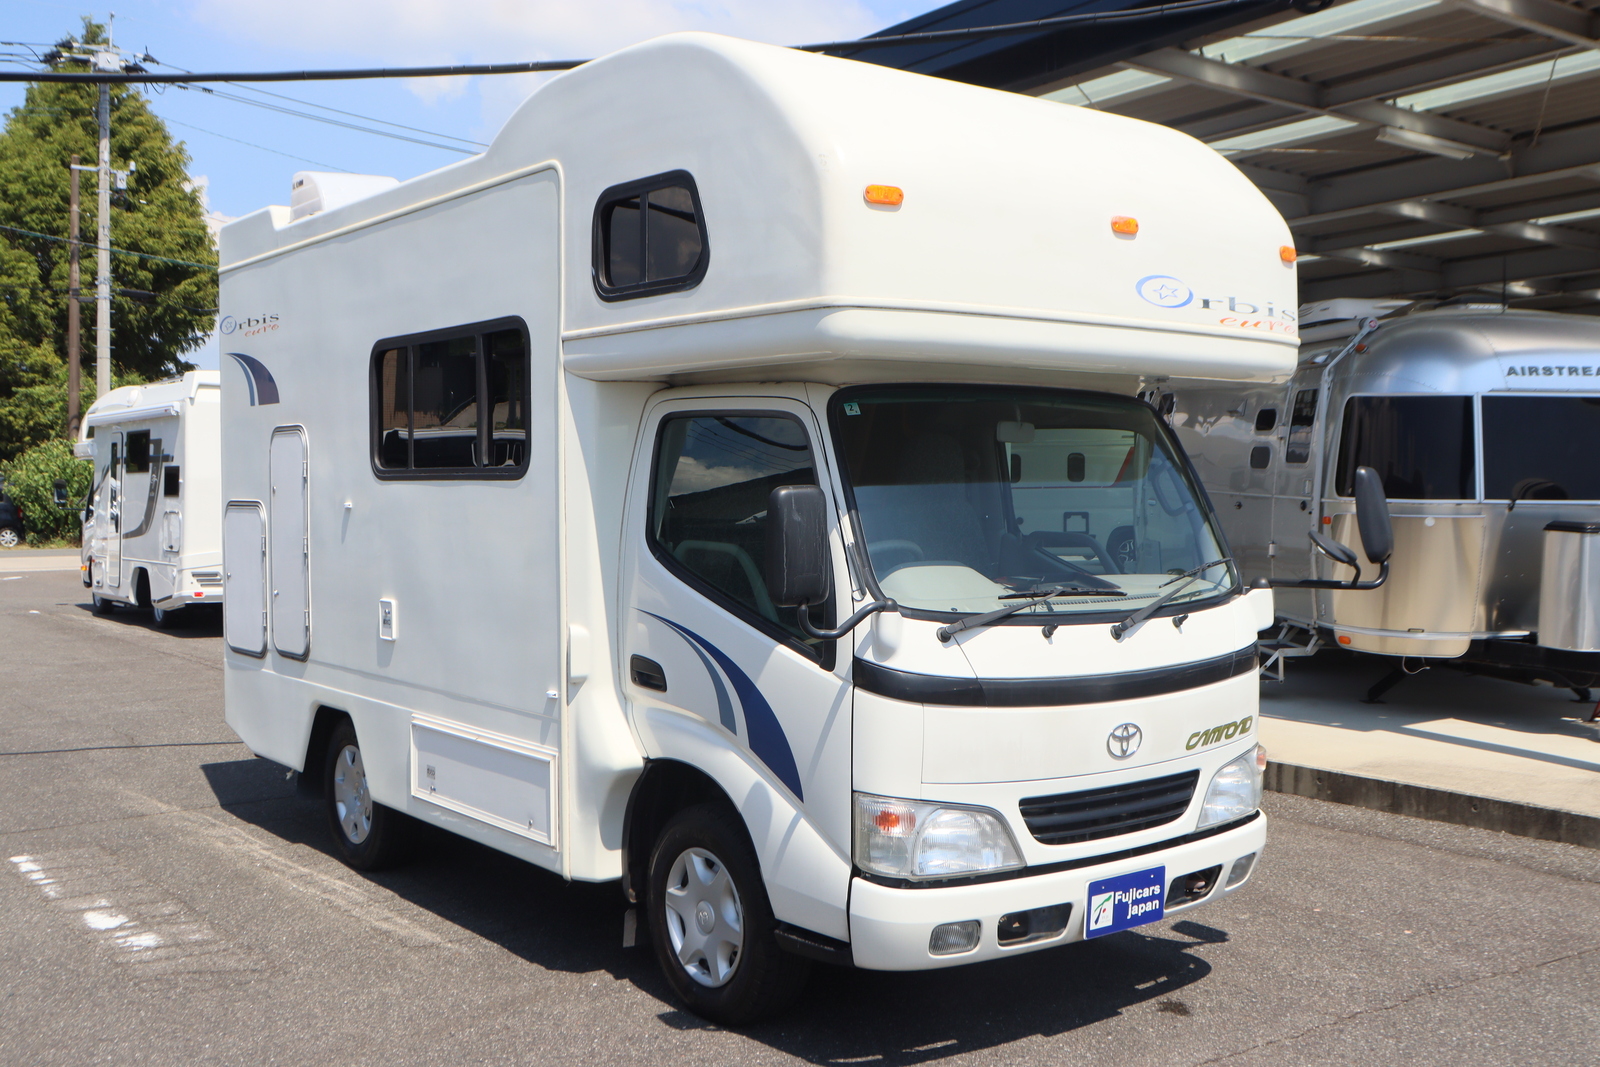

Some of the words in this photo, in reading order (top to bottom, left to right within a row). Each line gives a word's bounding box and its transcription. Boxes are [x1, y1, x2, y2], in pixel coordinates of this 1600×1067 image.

[1135, 274, 1296, 321] Orbis
[220, 313, 279, 335] Orbis
[244, 323, 279, 337] euro
[1219, 317, 1296, 334] euro
[1115, 884, 1160, 904] Fujicars
